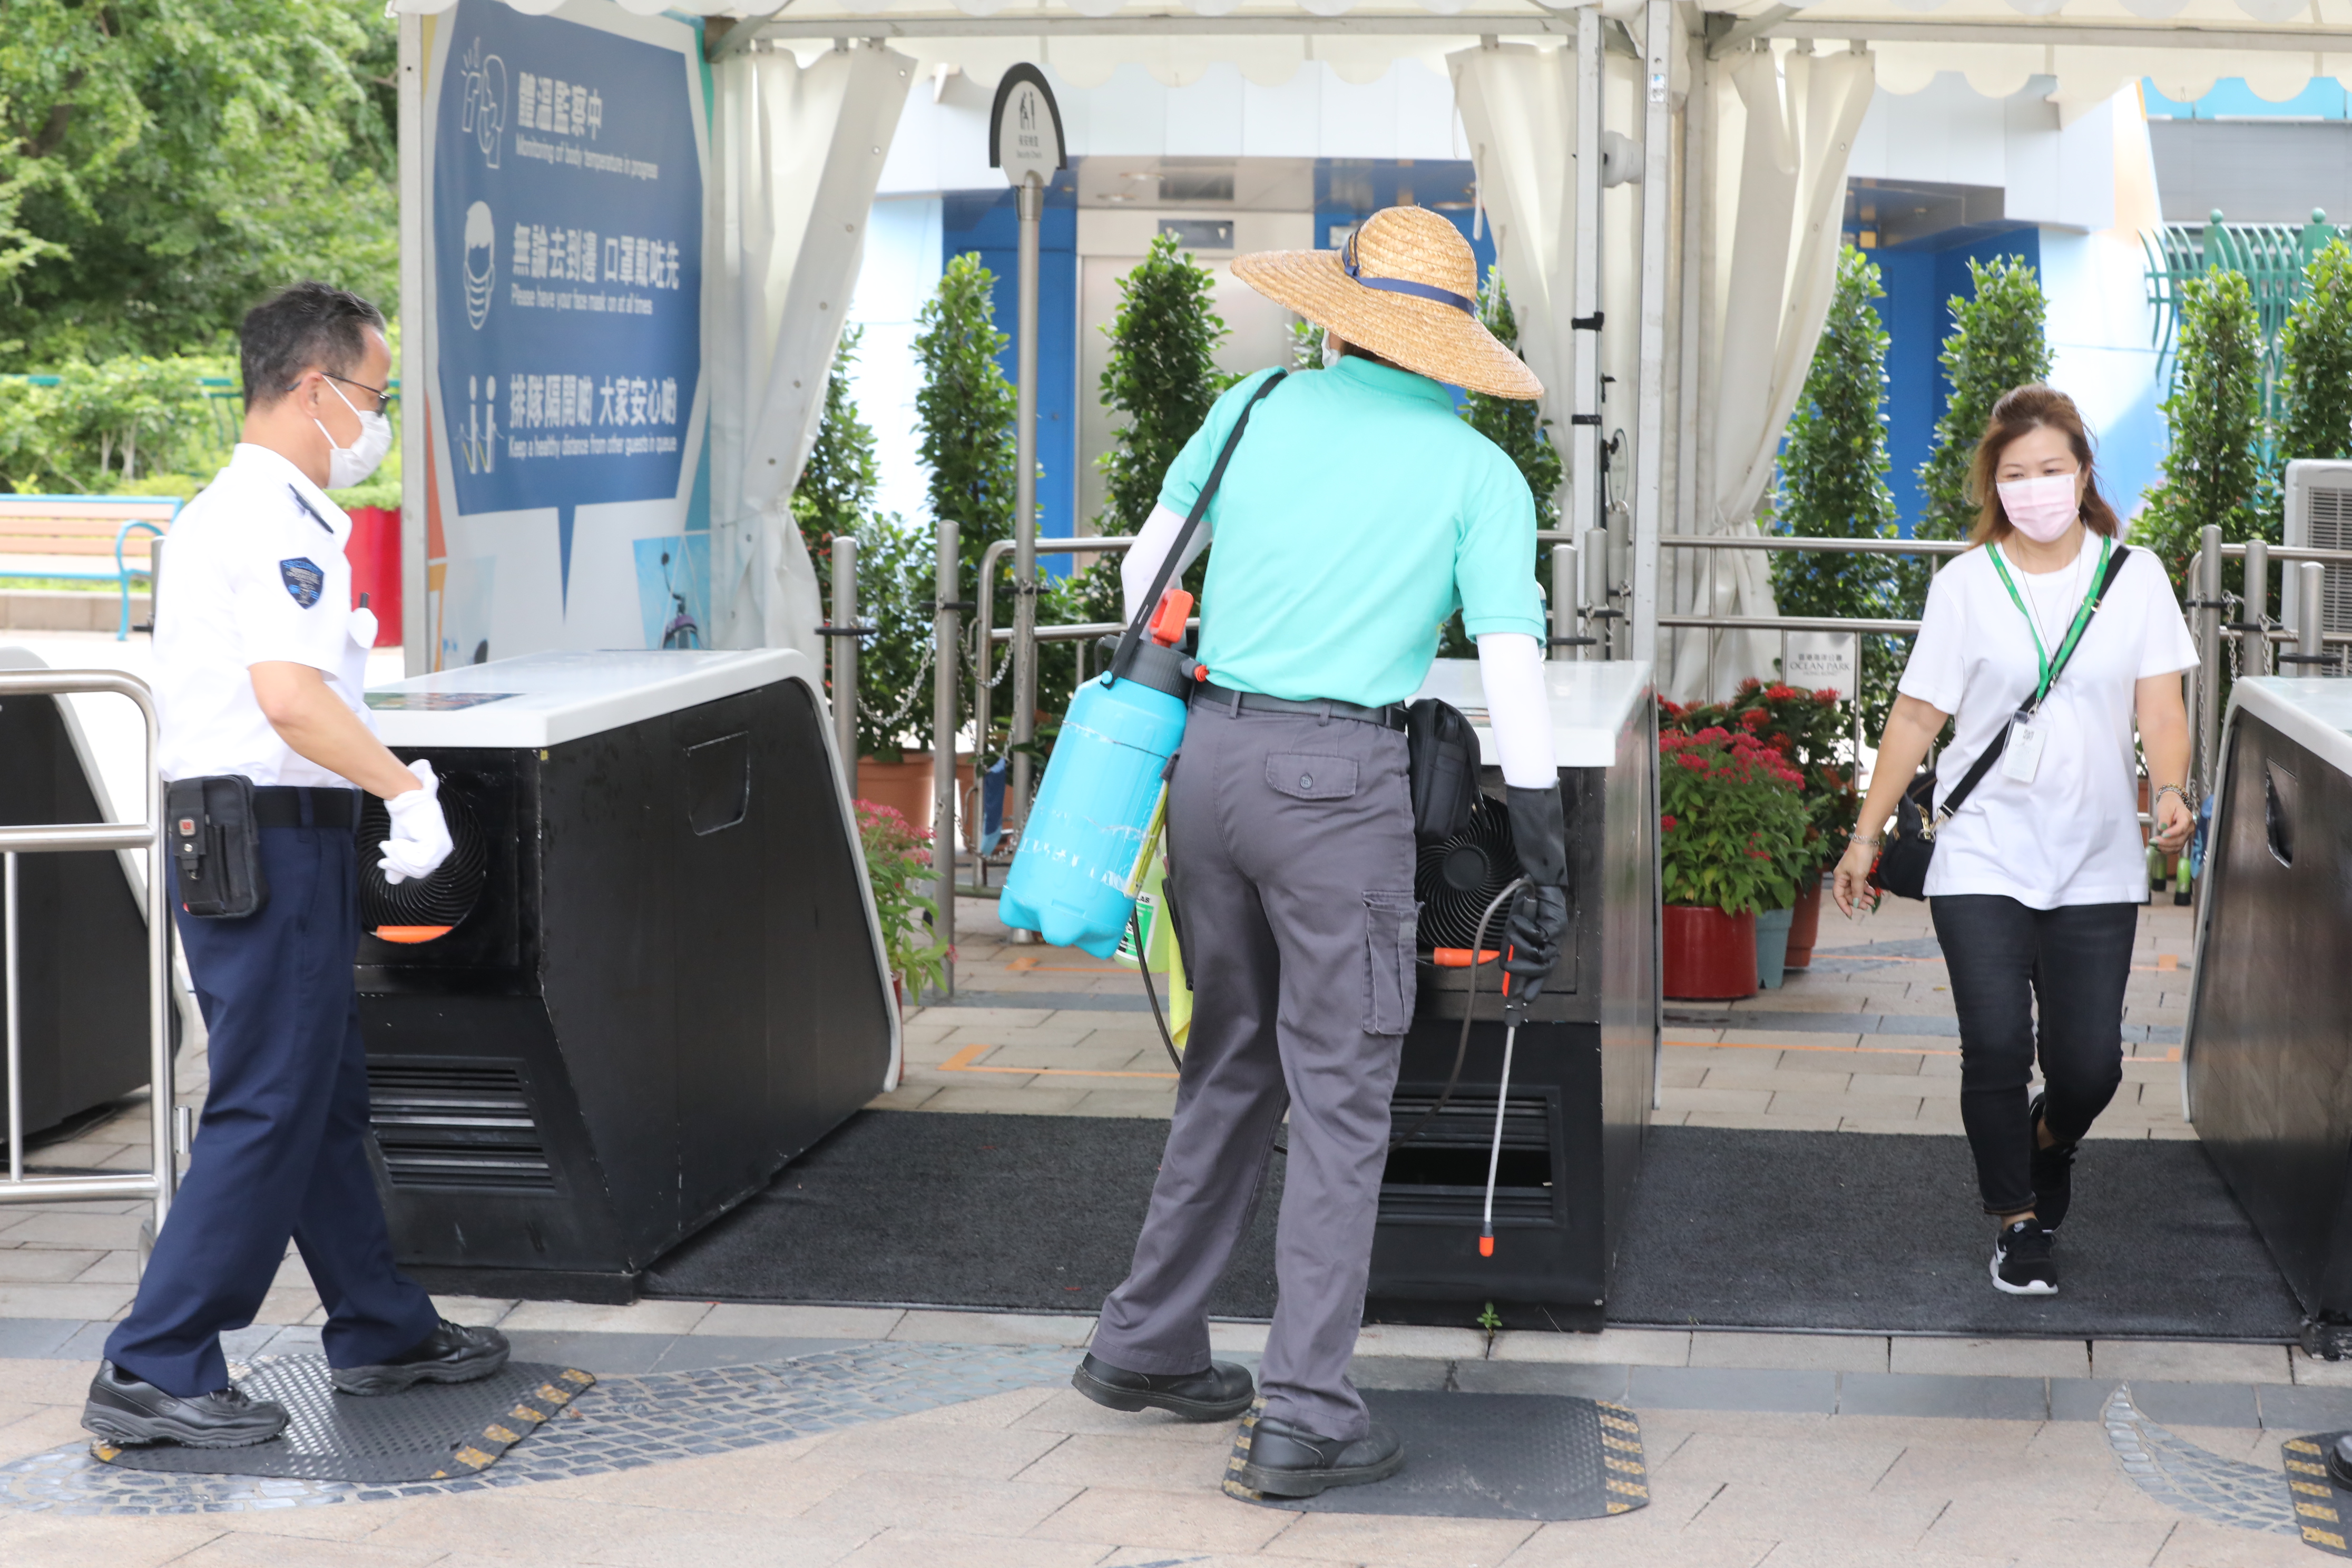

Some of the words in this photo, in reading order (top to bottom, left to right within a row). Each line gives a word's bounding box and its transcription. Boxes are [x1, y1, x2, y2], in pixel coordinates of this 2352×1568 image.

[516, 133, 554, 164] Monitoring
[555, 141, 564, 162] of
[565, 142, 582, 169] body
[584, 149, 623, 174] temperature
[631, 160, 658, 181] progress
[511, 282, 535, 307] Please
[536, 285, 555, 308] have
[556, 292, 572, 312] your
[573, 288, 587, 310] face
[589, 290, 606, 311] mask
[634, 293, 653, 315] times
[508, 435, 526, 461] Keep
[534, 435, 560, 460] healthy
[562, 433, 589, 456] distance
[590, 433, 606, 455] from
[625, 434, 648, 457] guests
[1790, 662, 1824, 670] OCEAN
[1826, 662, 1850, 671] PARK
